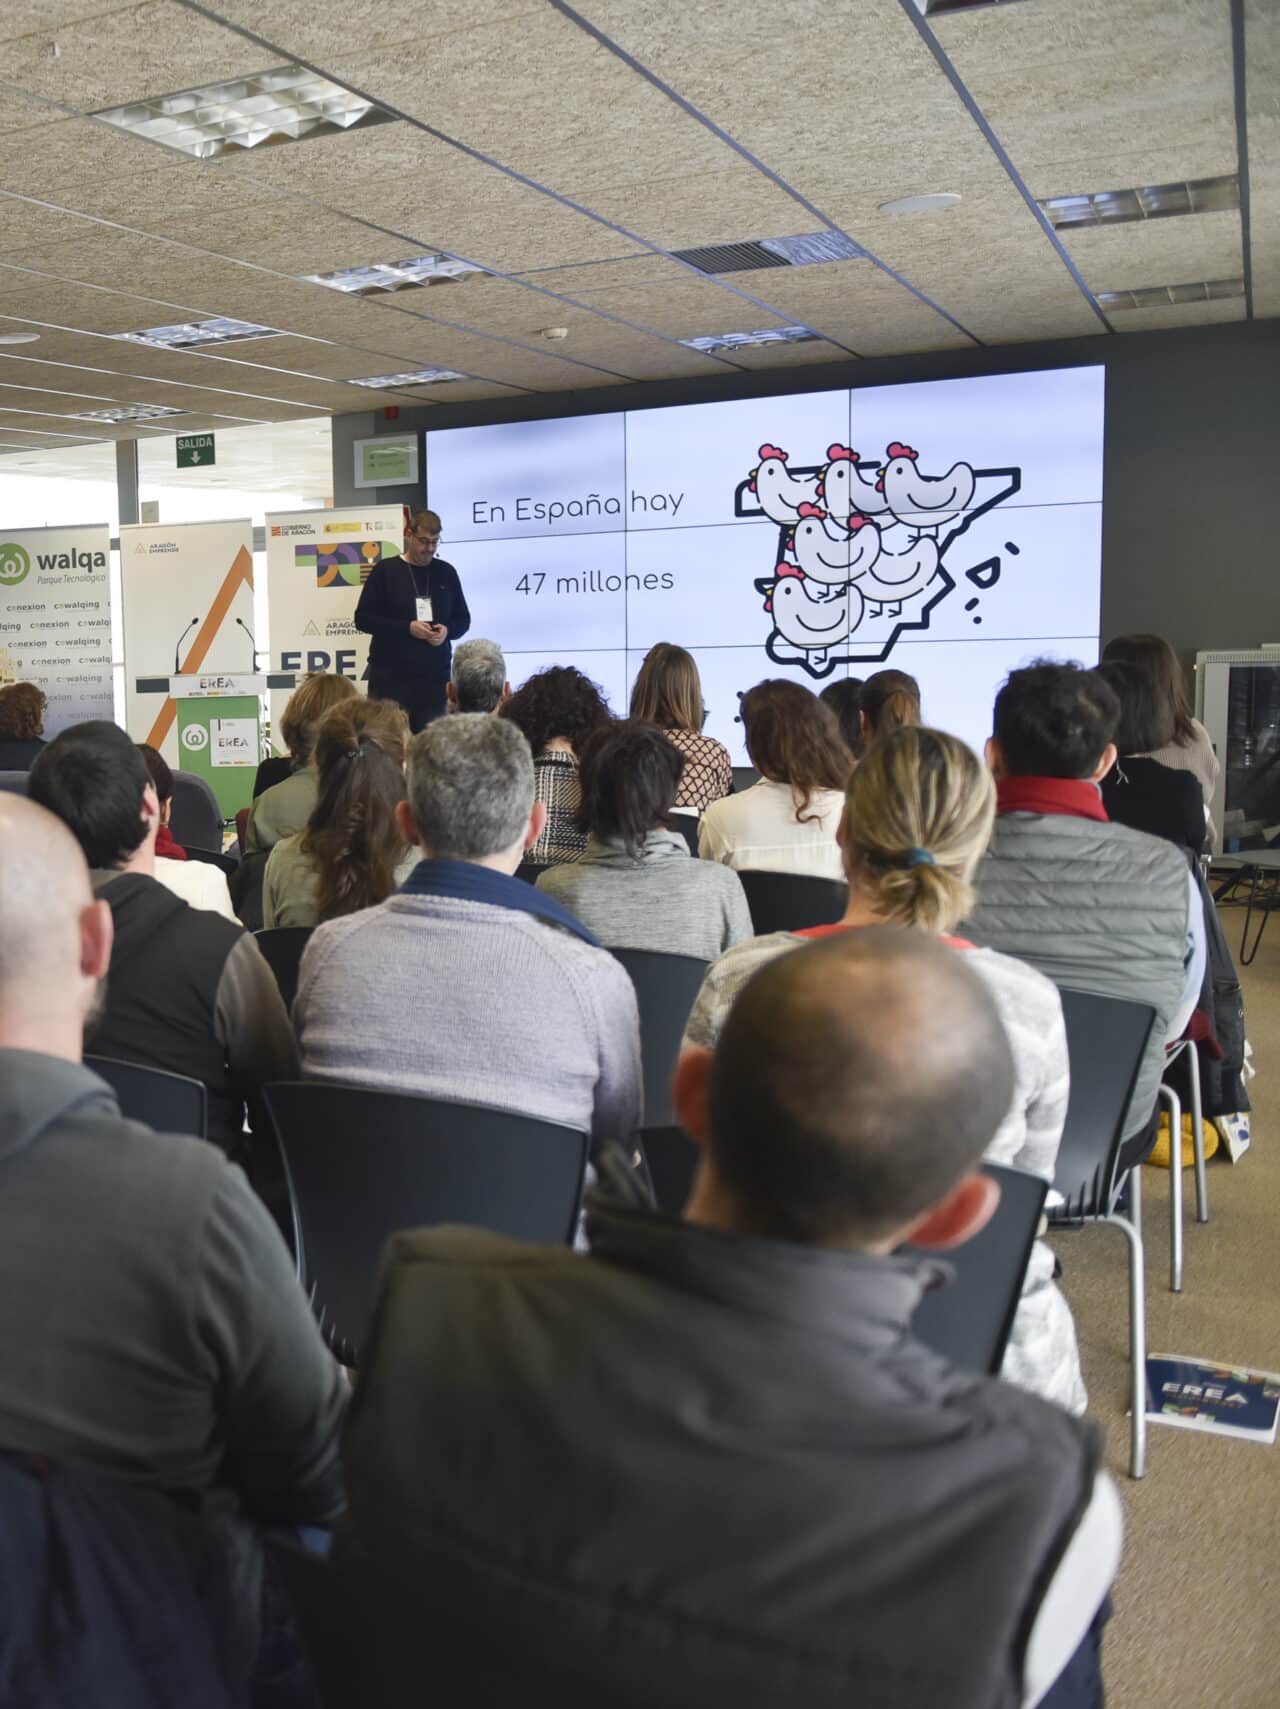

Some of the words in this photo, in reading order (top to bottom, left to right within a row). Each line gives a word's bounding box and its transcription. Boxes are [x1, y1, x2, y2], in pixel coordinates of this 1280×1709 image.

[178, 436, 212, 449] SALIDA
[472, 501, 505, 524] En
[516, 493, 621, 525] España
[631, 490, 684, 516] hay
[37, 547, 106, 573] walqa
[515, 572, 546, 595] 47
[556, 570, 674, 594] millones
